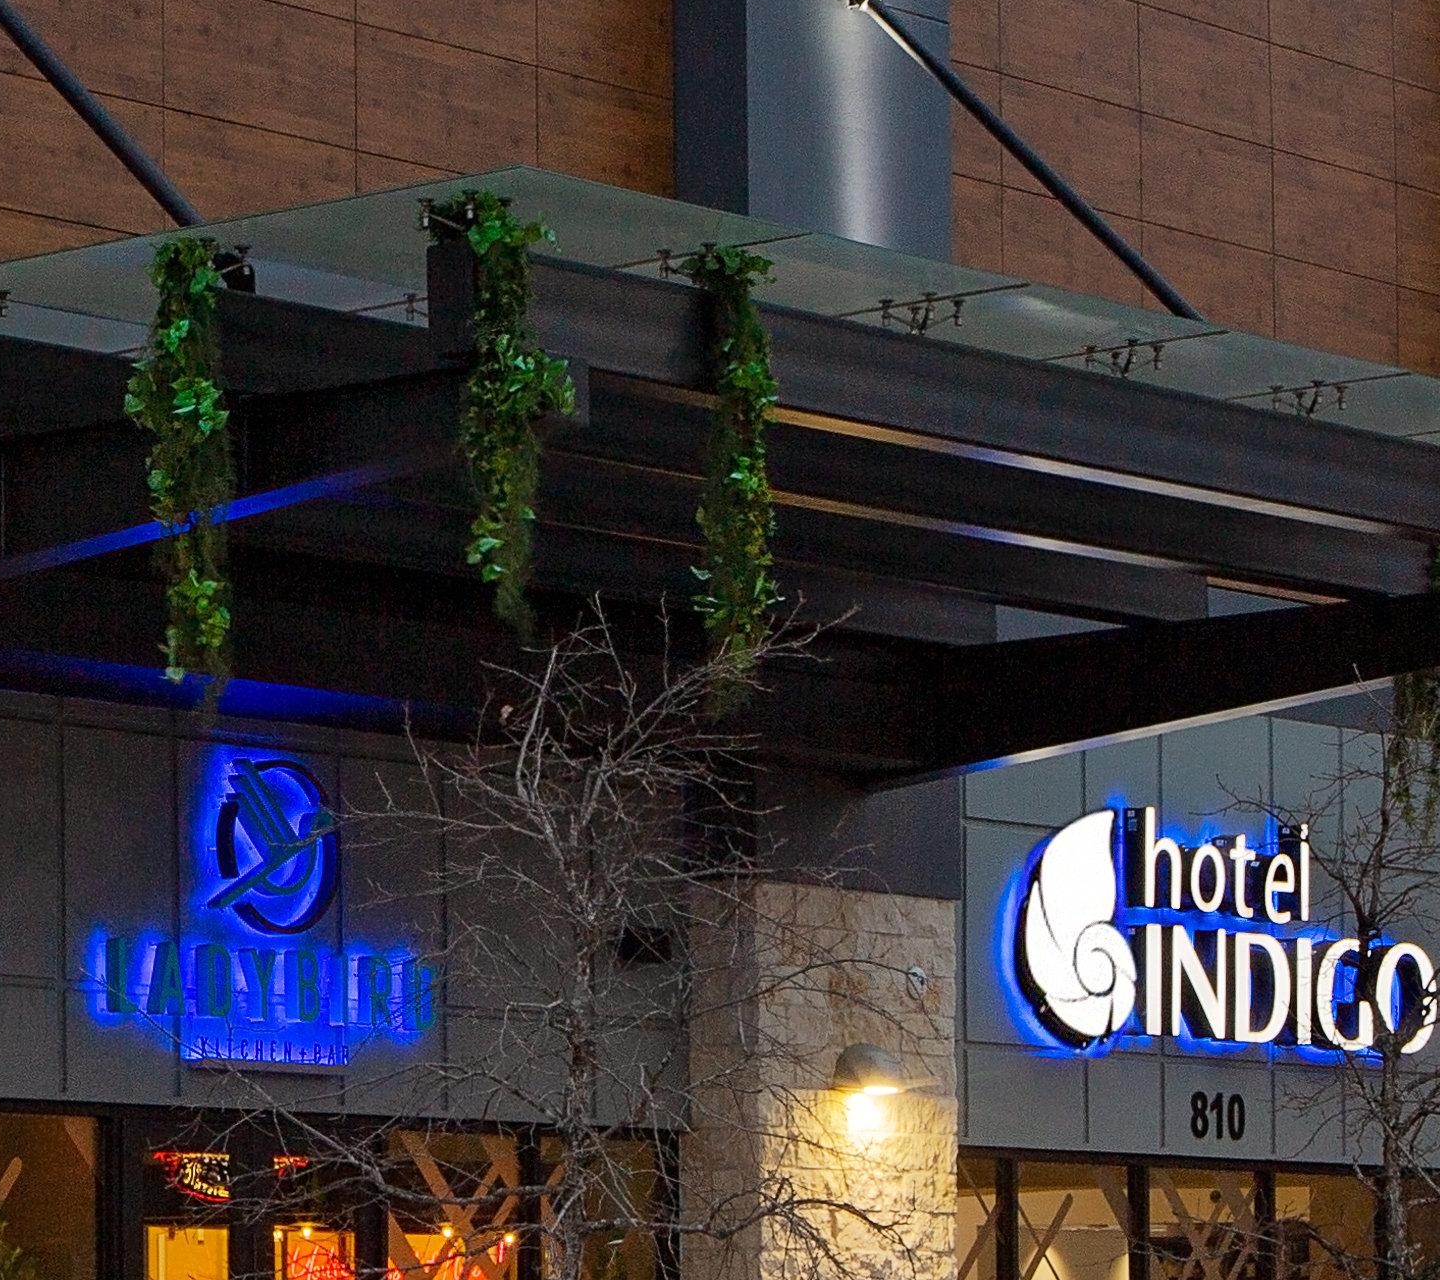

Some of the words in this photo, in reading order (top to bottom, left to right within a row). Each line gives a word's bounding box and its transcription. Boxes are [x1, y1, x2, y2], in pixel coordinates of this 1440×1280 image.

[1144, 806, 1310, 925] hotel
[106, 937, 437, 1031] LADYBIRD
[1145, 923, 1438, 1055] INDIGO
[1190, 1091, 1246, 1141] 810
